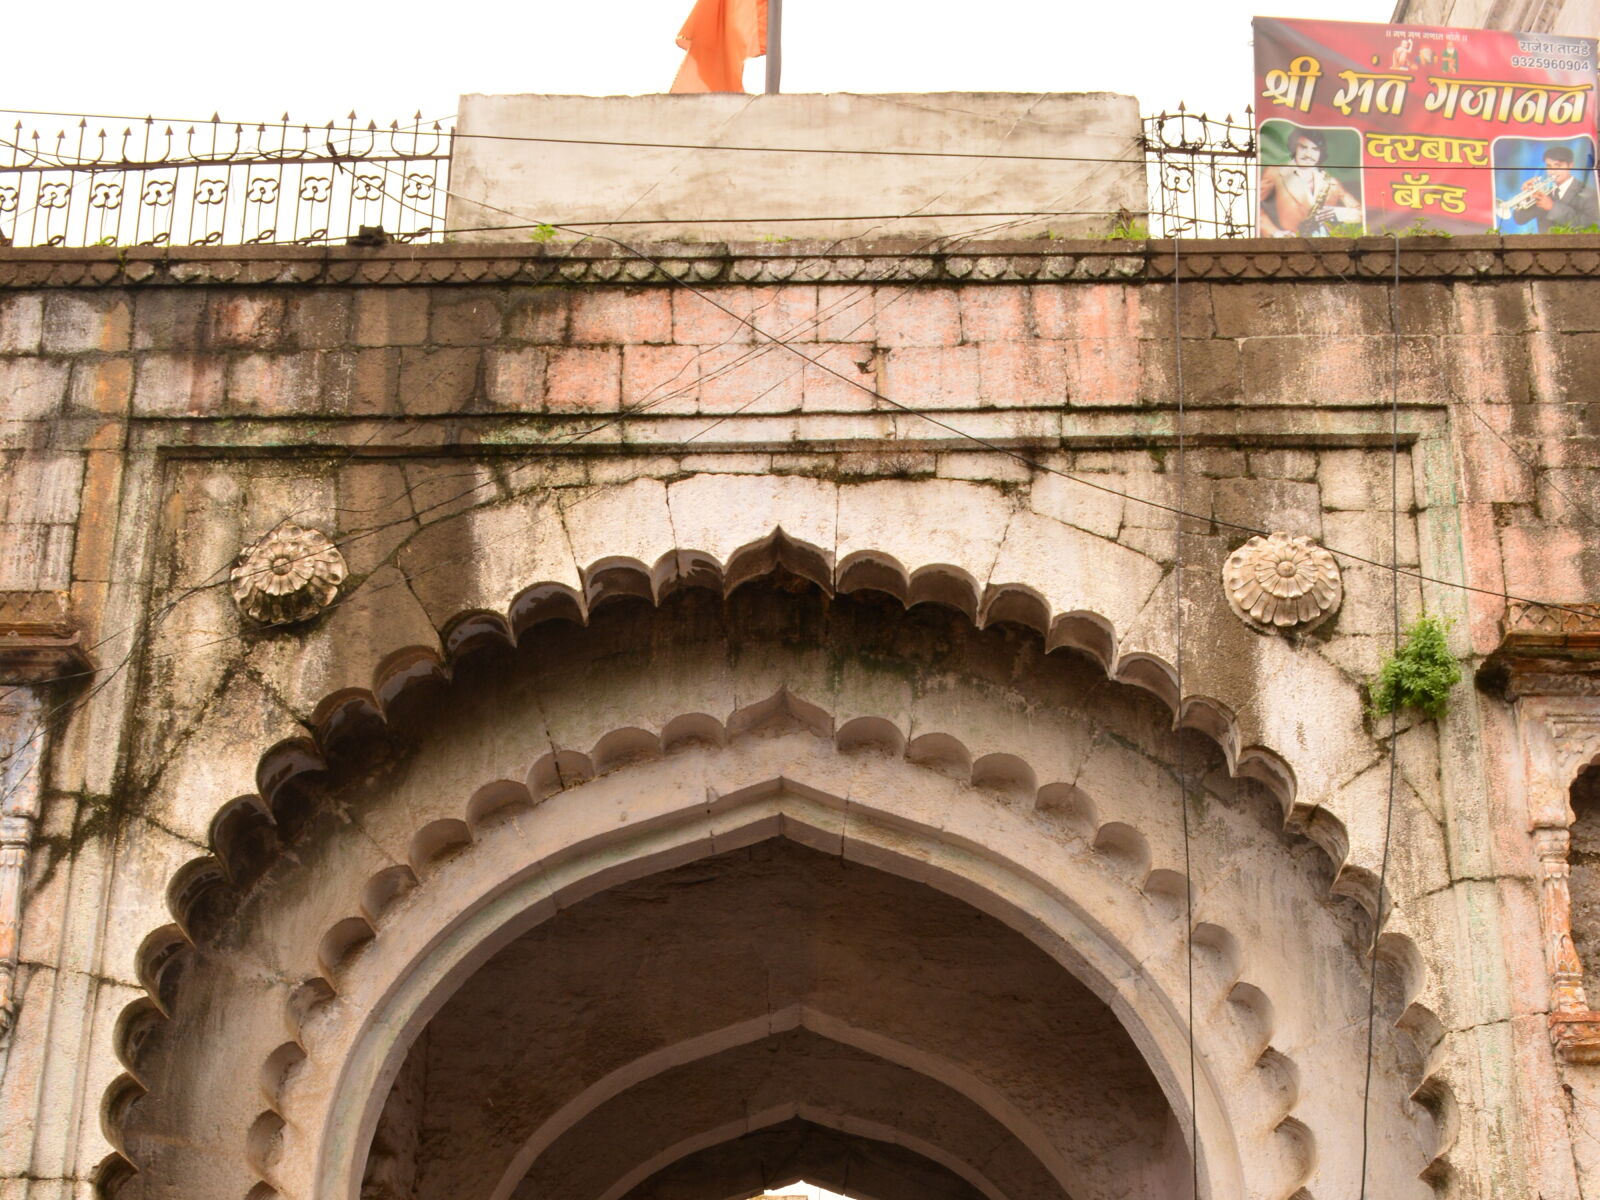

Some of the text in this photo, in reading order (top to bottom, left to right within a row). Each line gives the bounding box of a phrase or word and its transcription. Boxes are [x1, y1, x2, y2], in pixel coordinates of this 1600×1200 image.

[1519, 40, 1554, 54] राजेश
[1511, 56, 1590, 71] 9325960904
[1262, 56, 1323, 114] श्री
[1424, 76, 1594, 125] गजानन
[1364, 132, 1490, 166] दरबार
